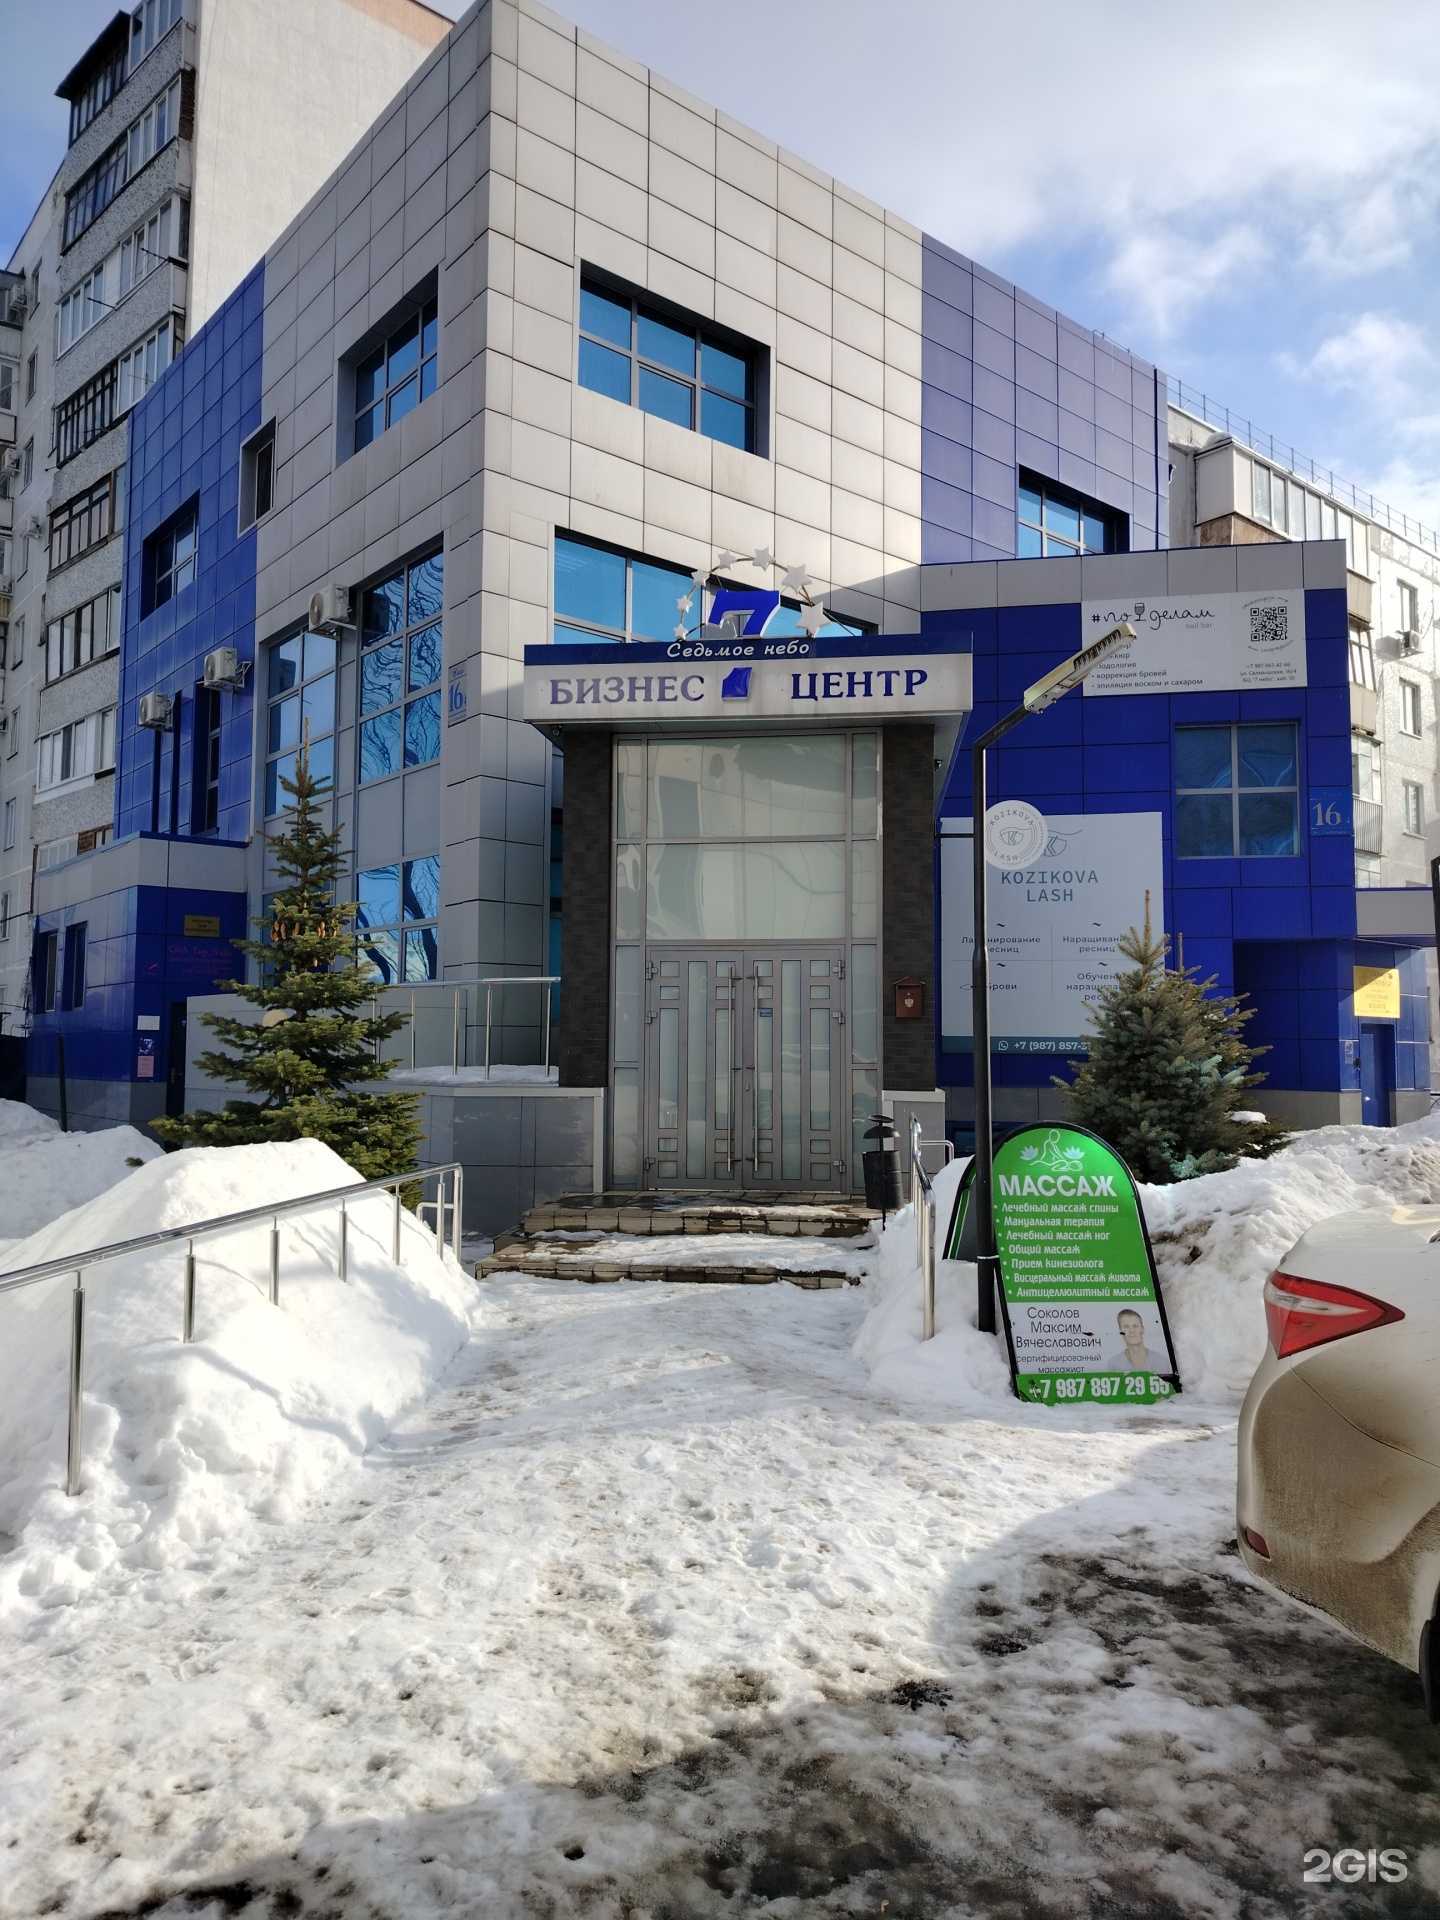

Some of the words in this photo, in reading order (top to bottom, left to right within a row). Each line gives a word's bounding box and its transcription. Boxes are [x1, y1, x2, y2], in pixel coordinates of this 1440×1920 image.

[667, 642, 754, 658] Седьмое
[764, 640, 810, 655] небо
[550, 675, 705, 705] БИЗНЕС
[791, 669, 928, 702] ЦЕНТР
[1171, 679, 1204, 687] сахаром
[1311, 801, 1342, 826] 16
[1001, 870, 1099, 885] KOZIKOVA
[1026, 888, 1074, 903] LASH
[961, 936, 1041, 945] Ланирование
[986, 946, 1020, 954] есниц
[1013, 1041, 1026, 1050] +7
[1029, 1041, 1056, 1051] (987)
[998, 1175, 1117, 1197] МАССАЖ
[1002, 1202, 1048, 1213] Лечебный
[1051, 1203, 1087, 1212] массаж
[1089, 1204, 1119, 1213] спины
[1004, 1217, 1061, 1228] Мануальная
[1064, 1218, 1104, 1228] терапия
[1006, 1230, 1053, 1240] Лечебный
[1056, 1231, 1092, 1240] массаж
[1095, 1231, 1110, 1240] ног
[1009, 1245, 1041, 1255] Общий
[1044, 1245, 1080, 1254] массаж
[1011, 1259, 1042, 1269] Прием
[1014, 1273, 1073, 1283] Висцеральный
[1075, 1273, 1106, 1282] массаж
[1016, 1287, 1110, 1298] Антицеллюлитный
[1112, 1287, 1149, 1297] массаж
[1027, 1306, 1080, 1319] Соколов
[1031, 1321, 1082, 1334] Максим
[1016, 1336, 1101, 1349] Вячеславович
[1016, 1354, 1102, 1364] сертифицированный
[1038, 1366, 1085, 1374] массажист
[1055, 1378, 1085, 1398] 987
[1090, 1377, 1120, 1397] 897
[1125, 1376, 1145, 1395] 29
